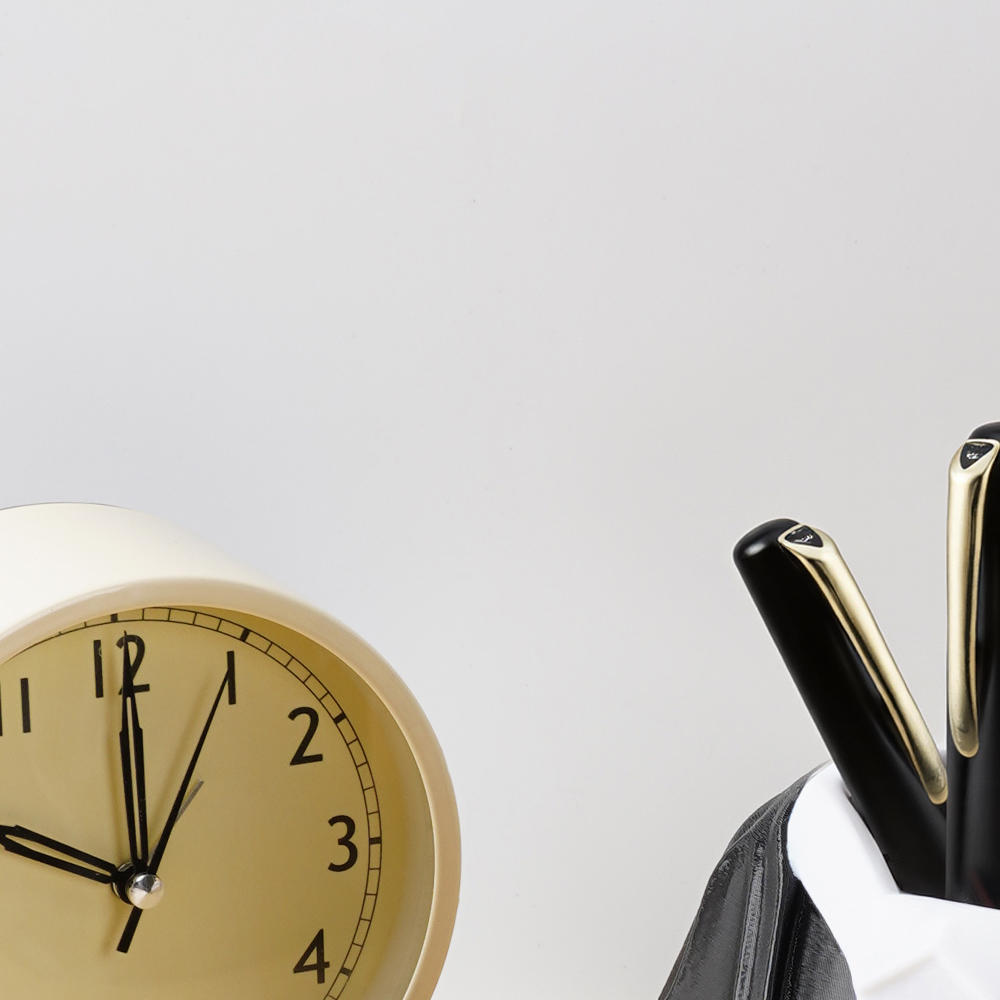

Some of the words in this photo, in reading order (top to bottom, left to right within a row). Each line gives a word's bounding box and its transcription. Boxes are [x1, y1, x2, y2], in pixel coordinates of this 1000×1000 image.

[93, 634, 150, 698] 12
[287, 706, 324, 766] 2
[327, 814, 359, 872] 3
[292, 928, 331, 984] 4
